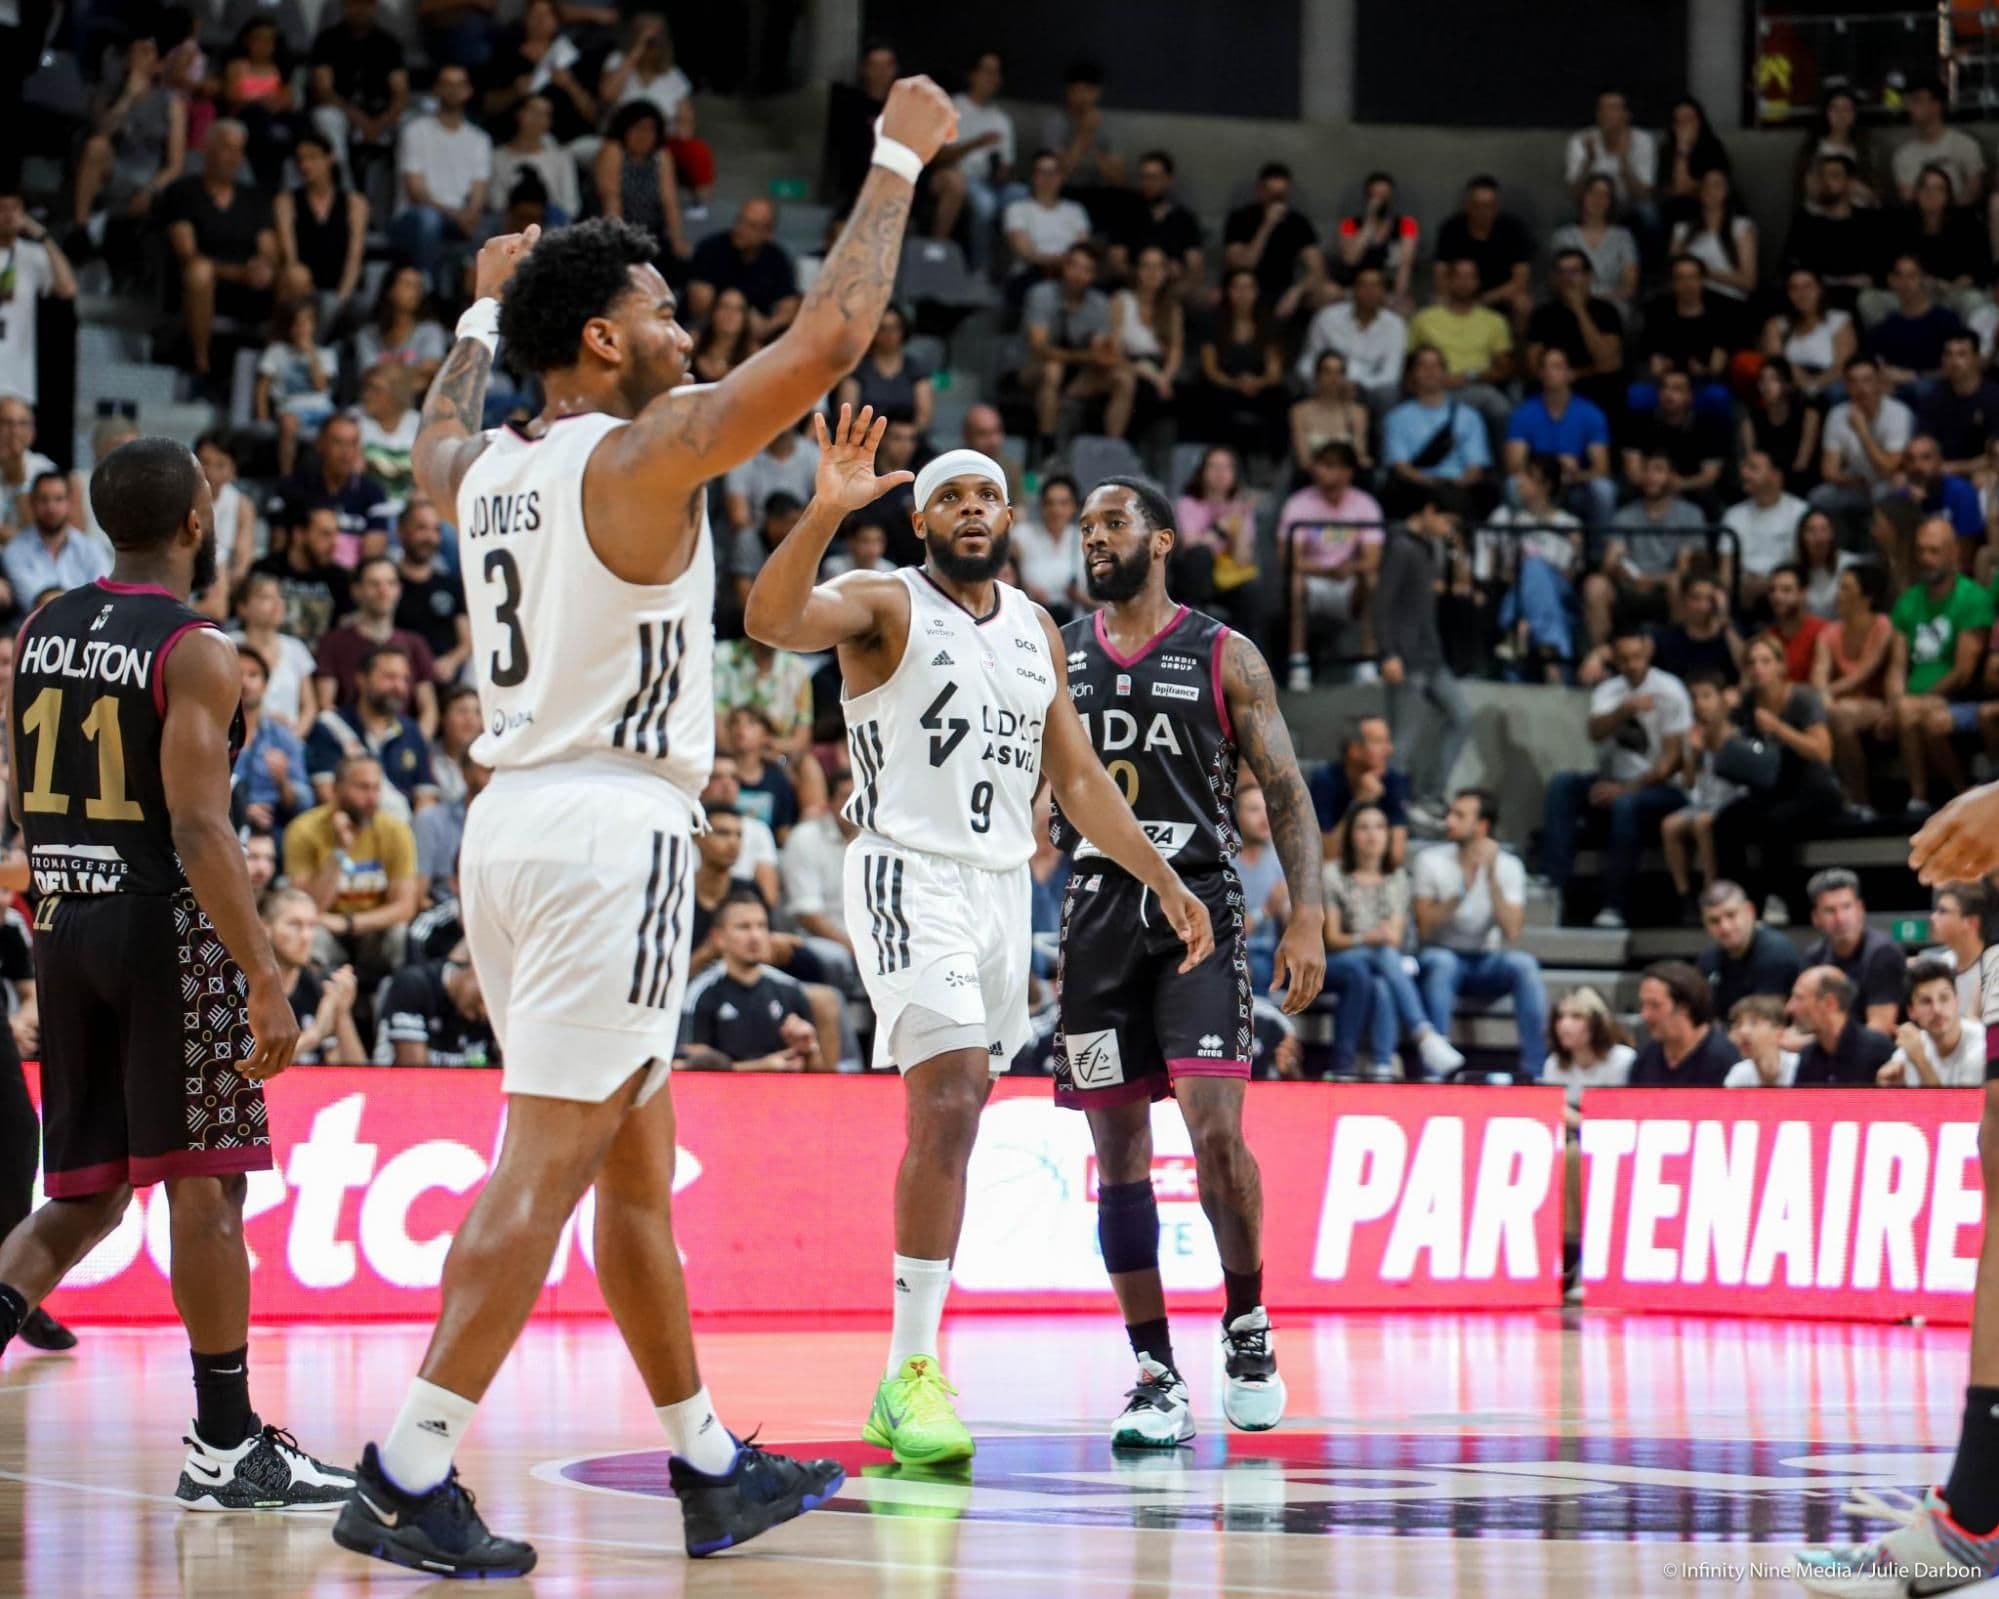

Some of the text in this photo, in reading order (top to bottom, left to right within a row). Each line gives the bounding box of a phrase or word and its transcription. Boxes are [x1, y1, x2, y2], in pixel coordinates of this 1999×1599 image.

[470, 490, 541, 539] JONES
[484, 547, 530, 687] 3
[20, 635, 152, 689] HOLSTON
[22, 687, 145, 821] 11
[970, 781, 994, 834] 9
[31, 857, 129, 874] FROMAGERIE
